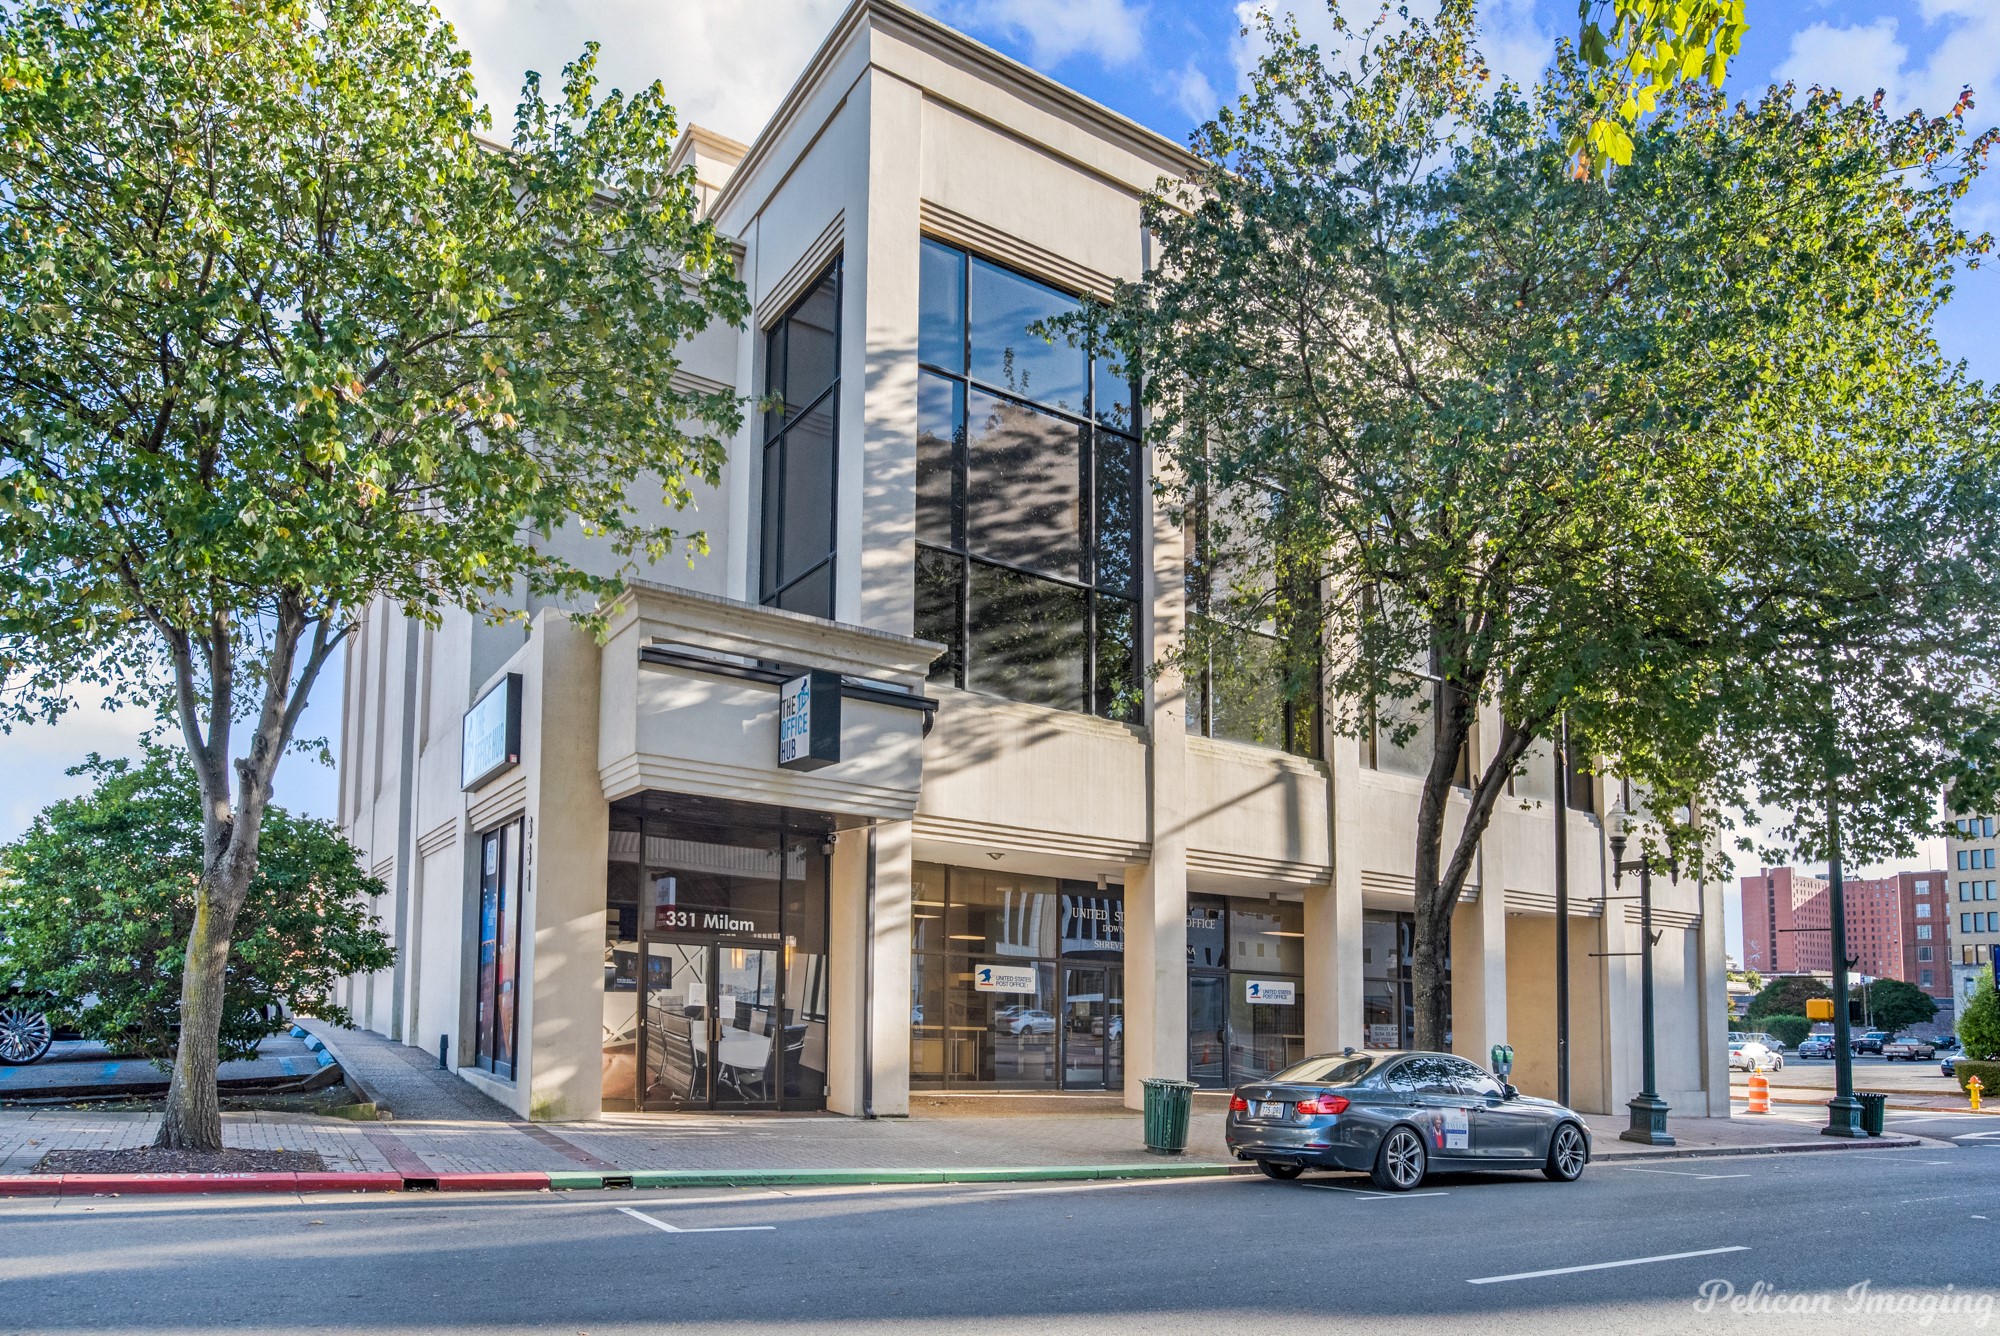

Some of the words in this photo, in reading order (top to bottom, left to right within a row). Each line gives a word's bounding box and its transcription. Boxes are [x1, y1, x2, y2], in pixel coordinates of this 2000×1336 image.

[782, 694, 796, 718] THE
[782, 712, 808, 740] OFFICE
[491, 721, 505, 762] HUB
[781, 739, 796, 762] HUB
[665, 910, 696, 928] 331
[703, 913, 755, 932] Milam
[1072, 907, 1108, 921] UNITED
[1186, 917, 1216, 929] OFFICE
[1102, 924, 1124, 933] DOWN
[1094, 940, 1124, 950] SHREVE
